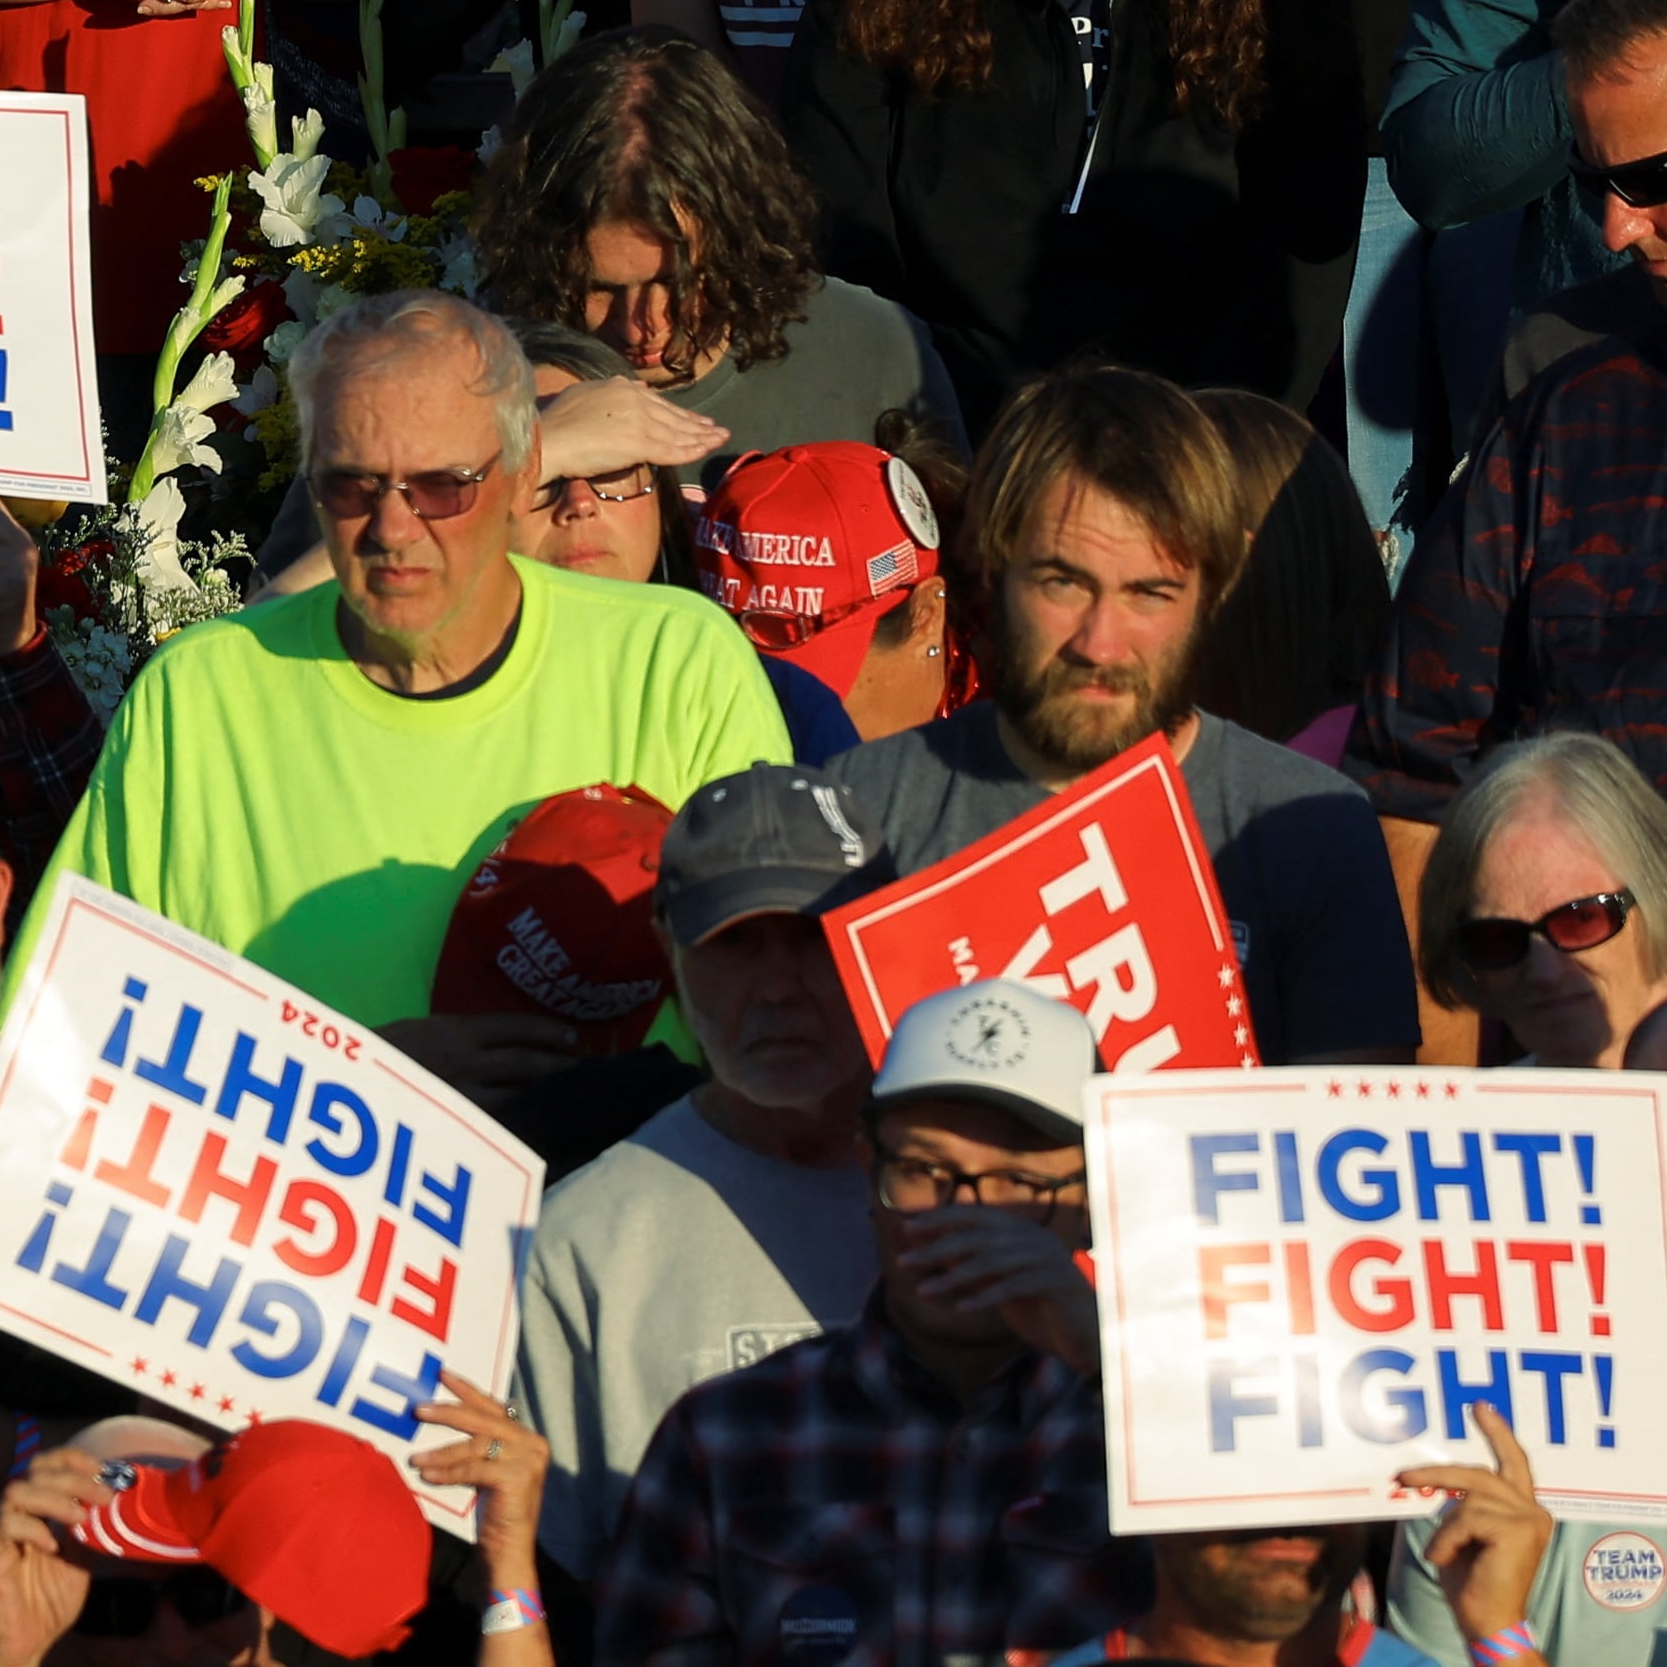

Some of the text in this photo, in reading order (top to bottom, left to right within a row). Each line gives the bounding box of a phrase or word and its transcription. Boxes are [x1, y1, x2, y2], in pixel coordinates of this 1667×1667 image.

[742, 586, 825, 615] AGAIN
[279, 999, 361, 1061] 2024
[98, 977, 473, 1245] FIGHT!
[59, 1077, 458, 1344] FIGHT!
[1189, 1127, 1601, 1226] FIGHT!
[16, 1184, 443, 1440] FIGHT!
[1199, 1237, 1613, 1340] FIGHT!
[1206, 1347, 1619, 1453] FIGHT!
[1585, 1564, 1662, 1583] TRUMP
[1593, 1547, 1655, 1566] TEAM
